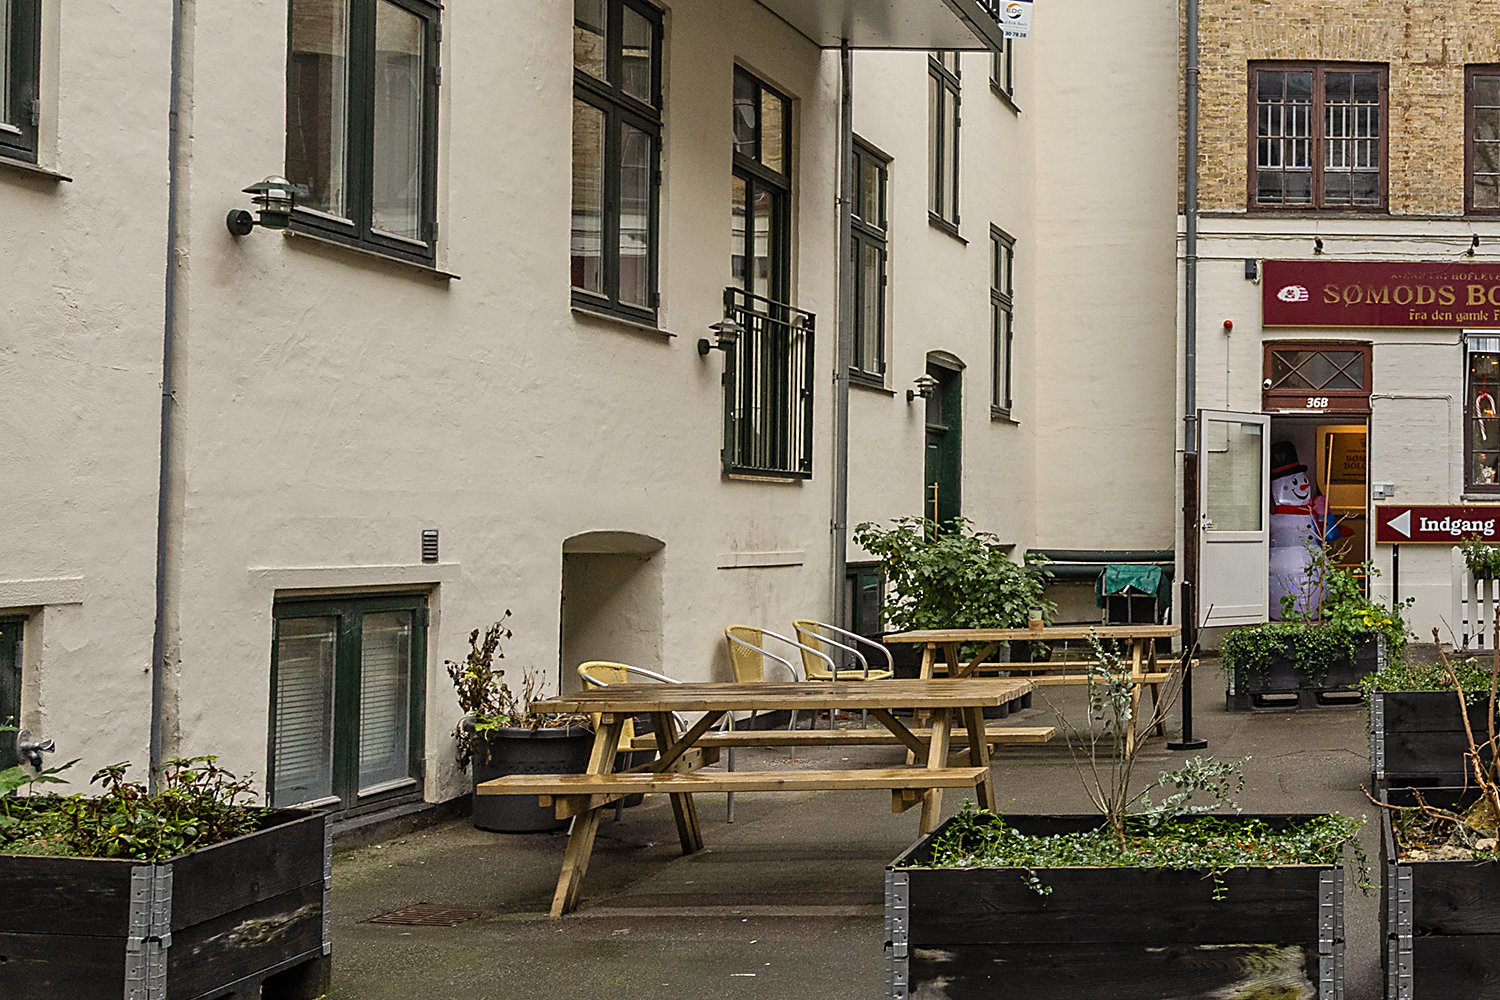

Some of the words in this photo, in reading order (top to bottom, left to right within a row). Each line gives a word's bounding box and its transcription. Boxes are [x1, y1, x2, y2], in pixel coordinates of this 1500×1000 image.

[1322, 283, 1456, 307] SØMODS
[1409, 309, 1428, 320] Fra
[1431, 309, 1452, 321] den
[1455, 309, 1489, 322] gamle
[1306, 397, 1328, 408] 36B
[1420, 516, 1495, 536] Indgang
